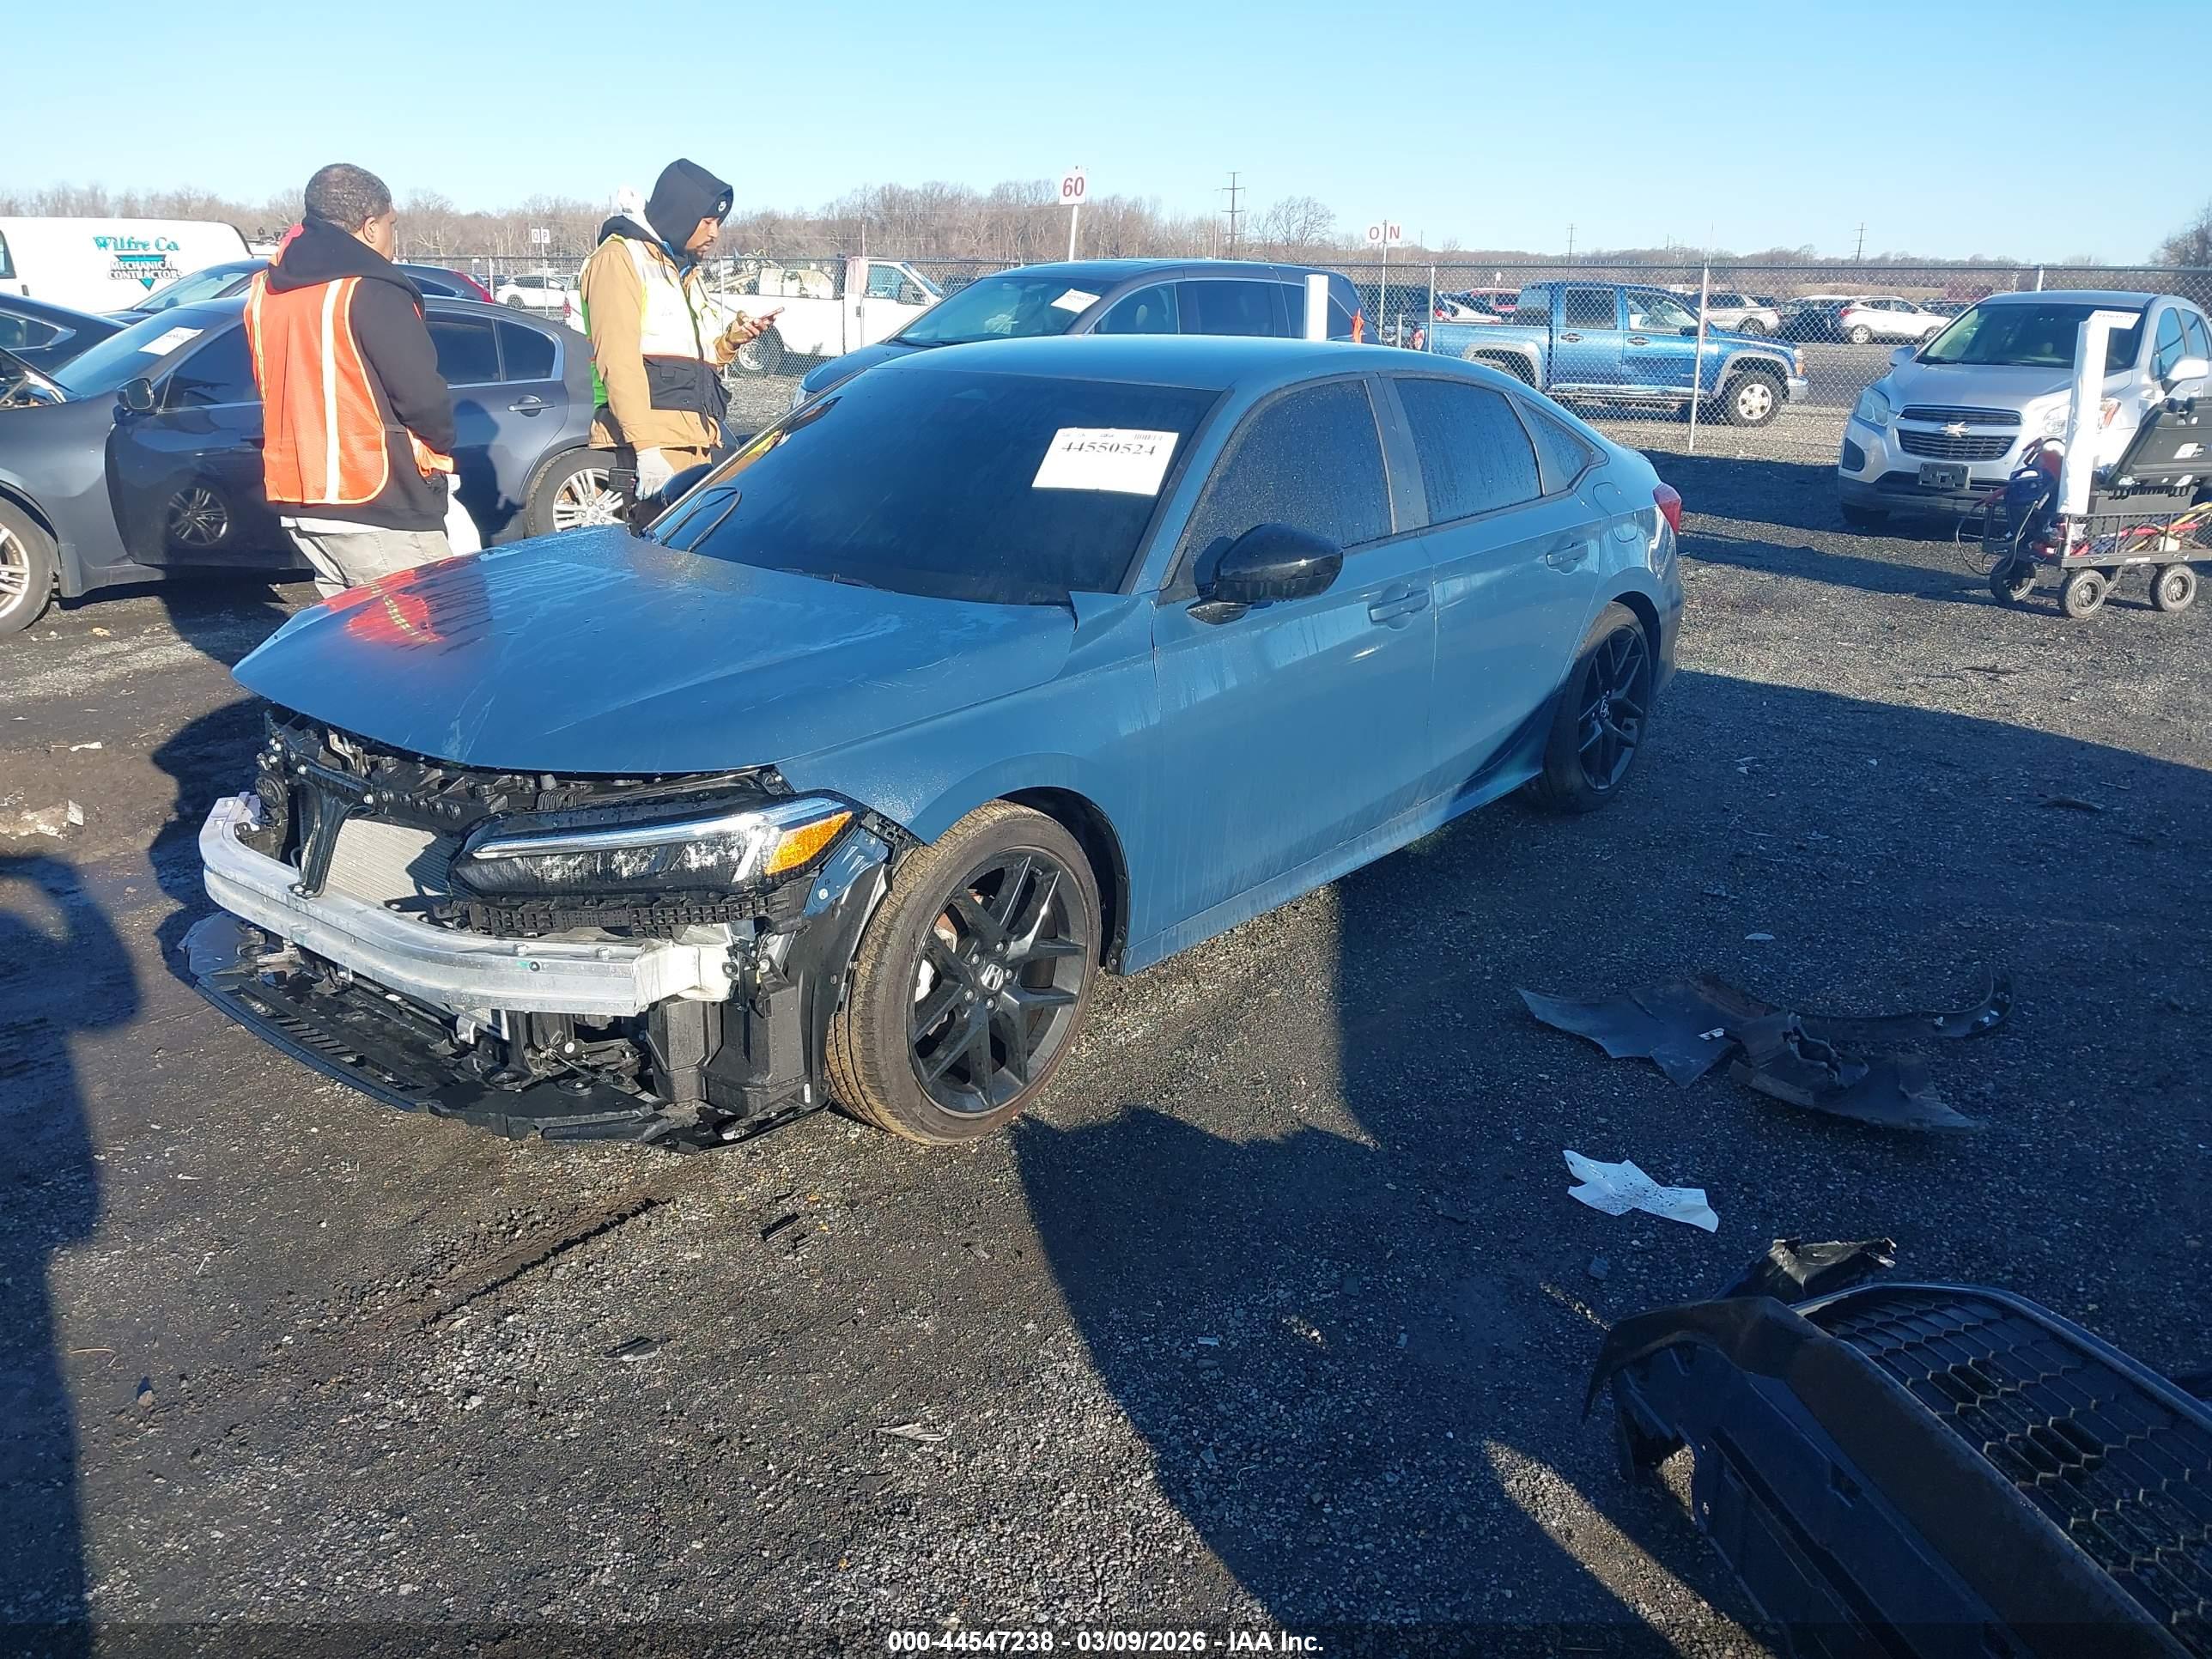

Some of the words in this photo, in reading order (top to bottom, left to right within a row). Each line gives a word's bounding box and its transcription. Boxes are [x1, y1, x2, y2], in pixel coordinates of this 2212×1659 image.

[1063, 177, 1085, 197] 60
[543, 232, 548, 241] P
[1370, 227, 1379, 240] O
[1389, 226, 1400, 239] N
[109, 270, 183, 279] CONTRACTORS
[1060, 441, 1156, 455] 44550524
